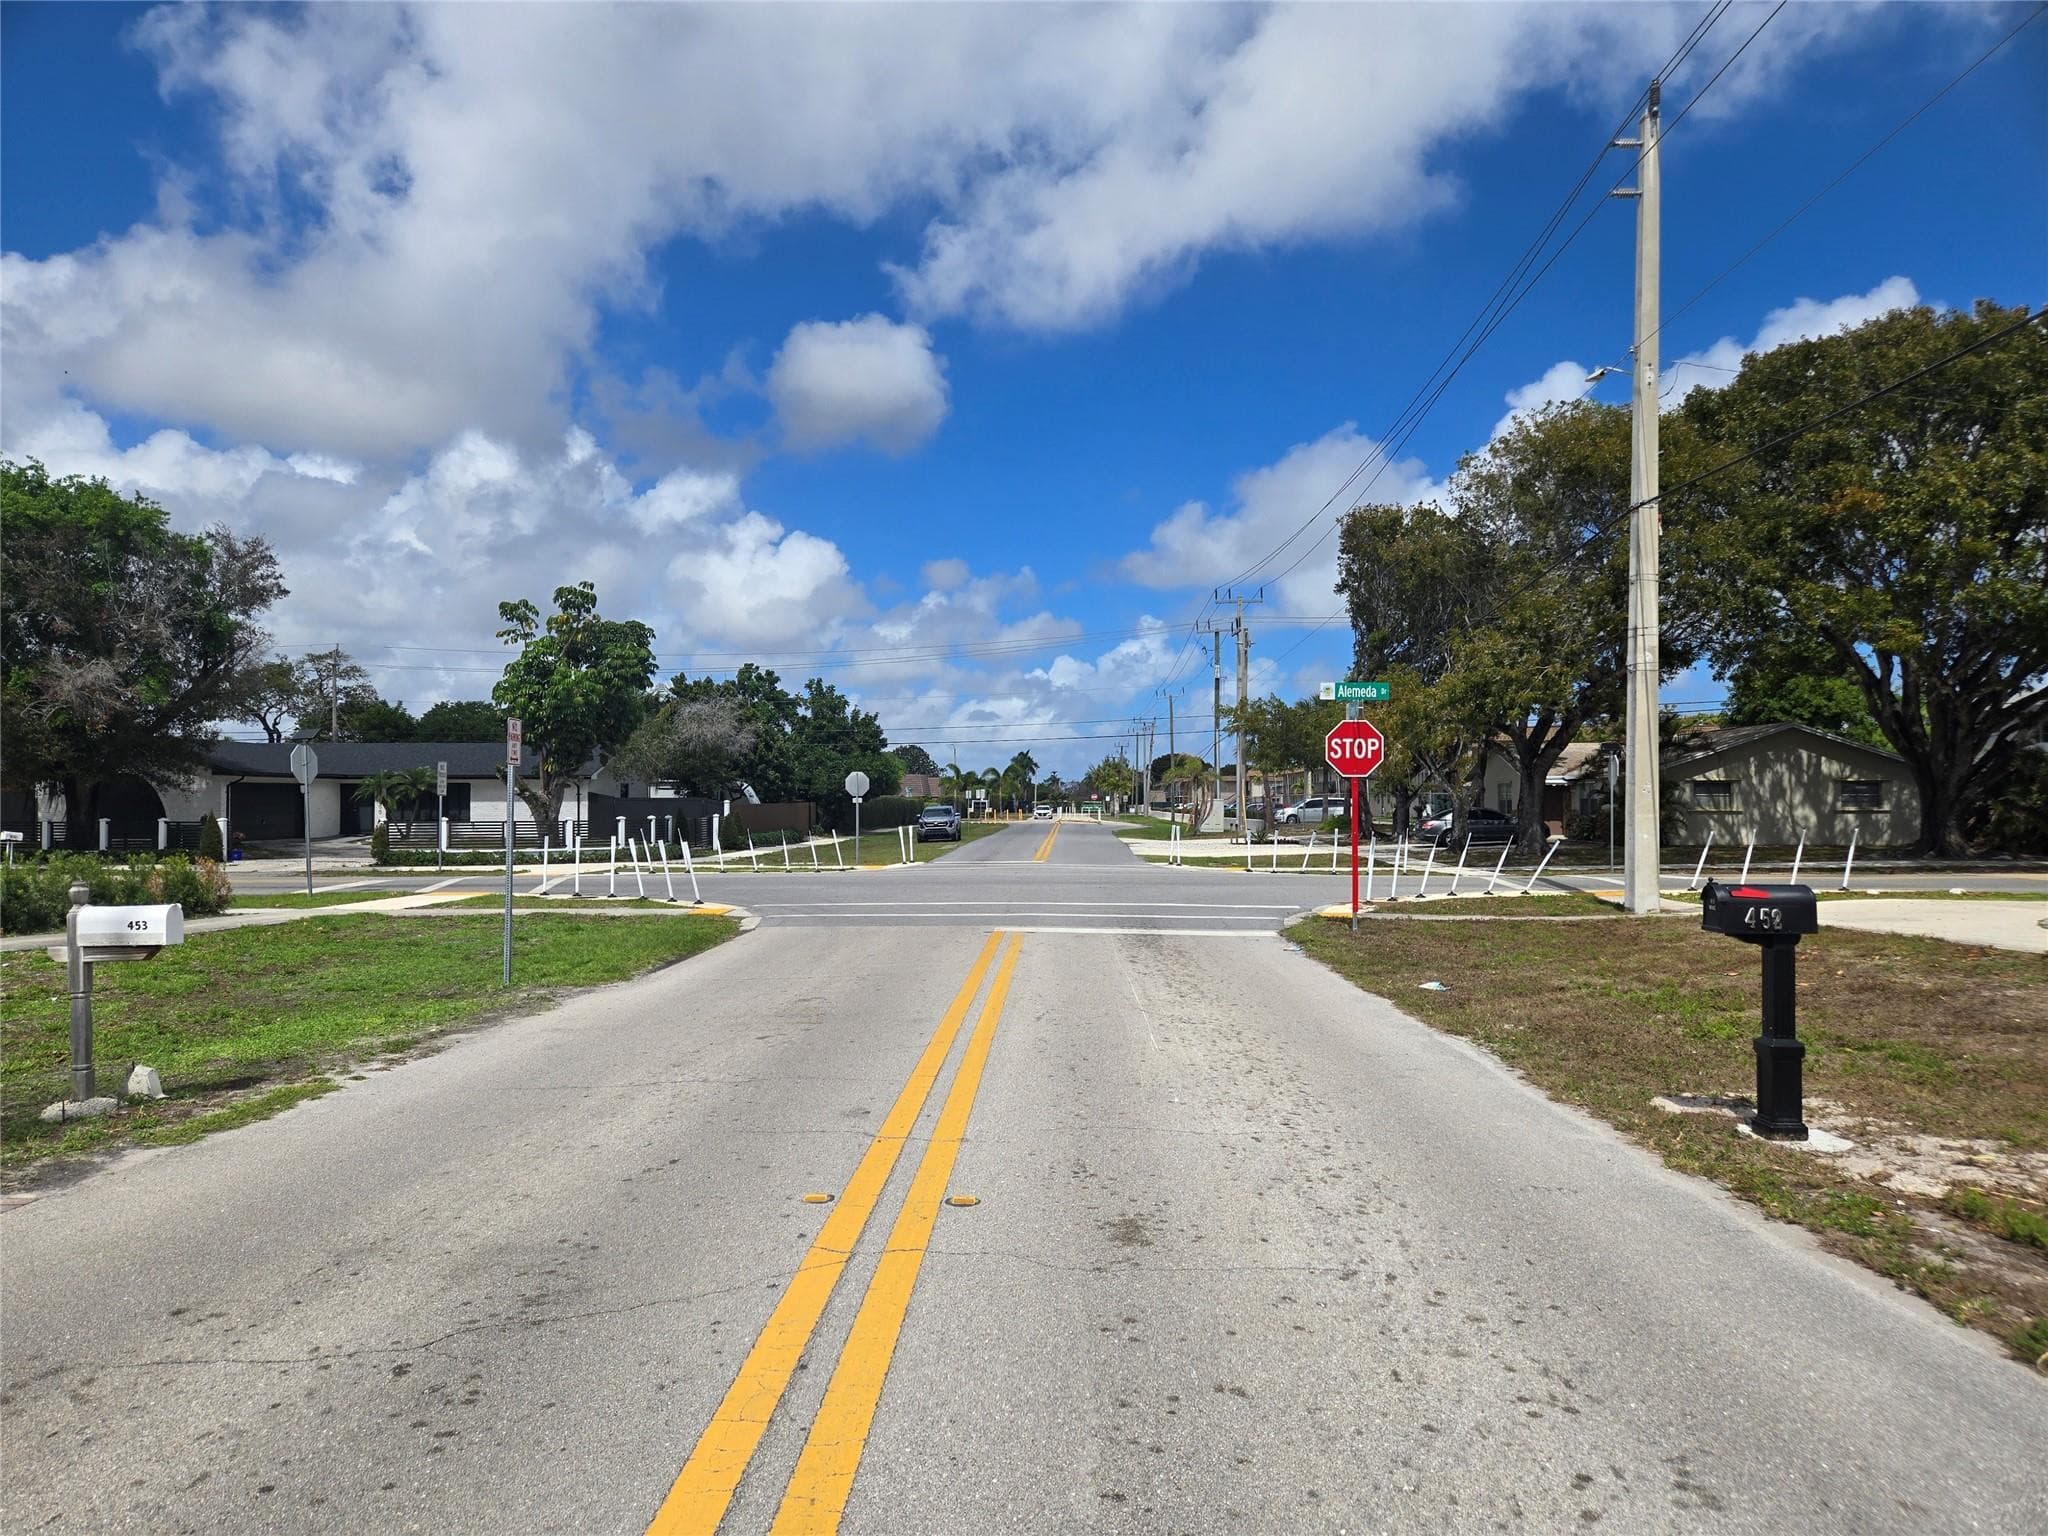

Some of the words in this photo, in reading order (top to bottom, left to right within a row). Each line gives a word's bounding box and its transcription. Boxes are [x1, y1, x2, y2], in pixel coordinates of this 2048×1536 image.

[1337, 686, 1377, 698] Alemeda
[1330, 738, 1379, 759] STOP
[127, 920, 148, 931] 453
[1744, 906, 1783, 930] 452
